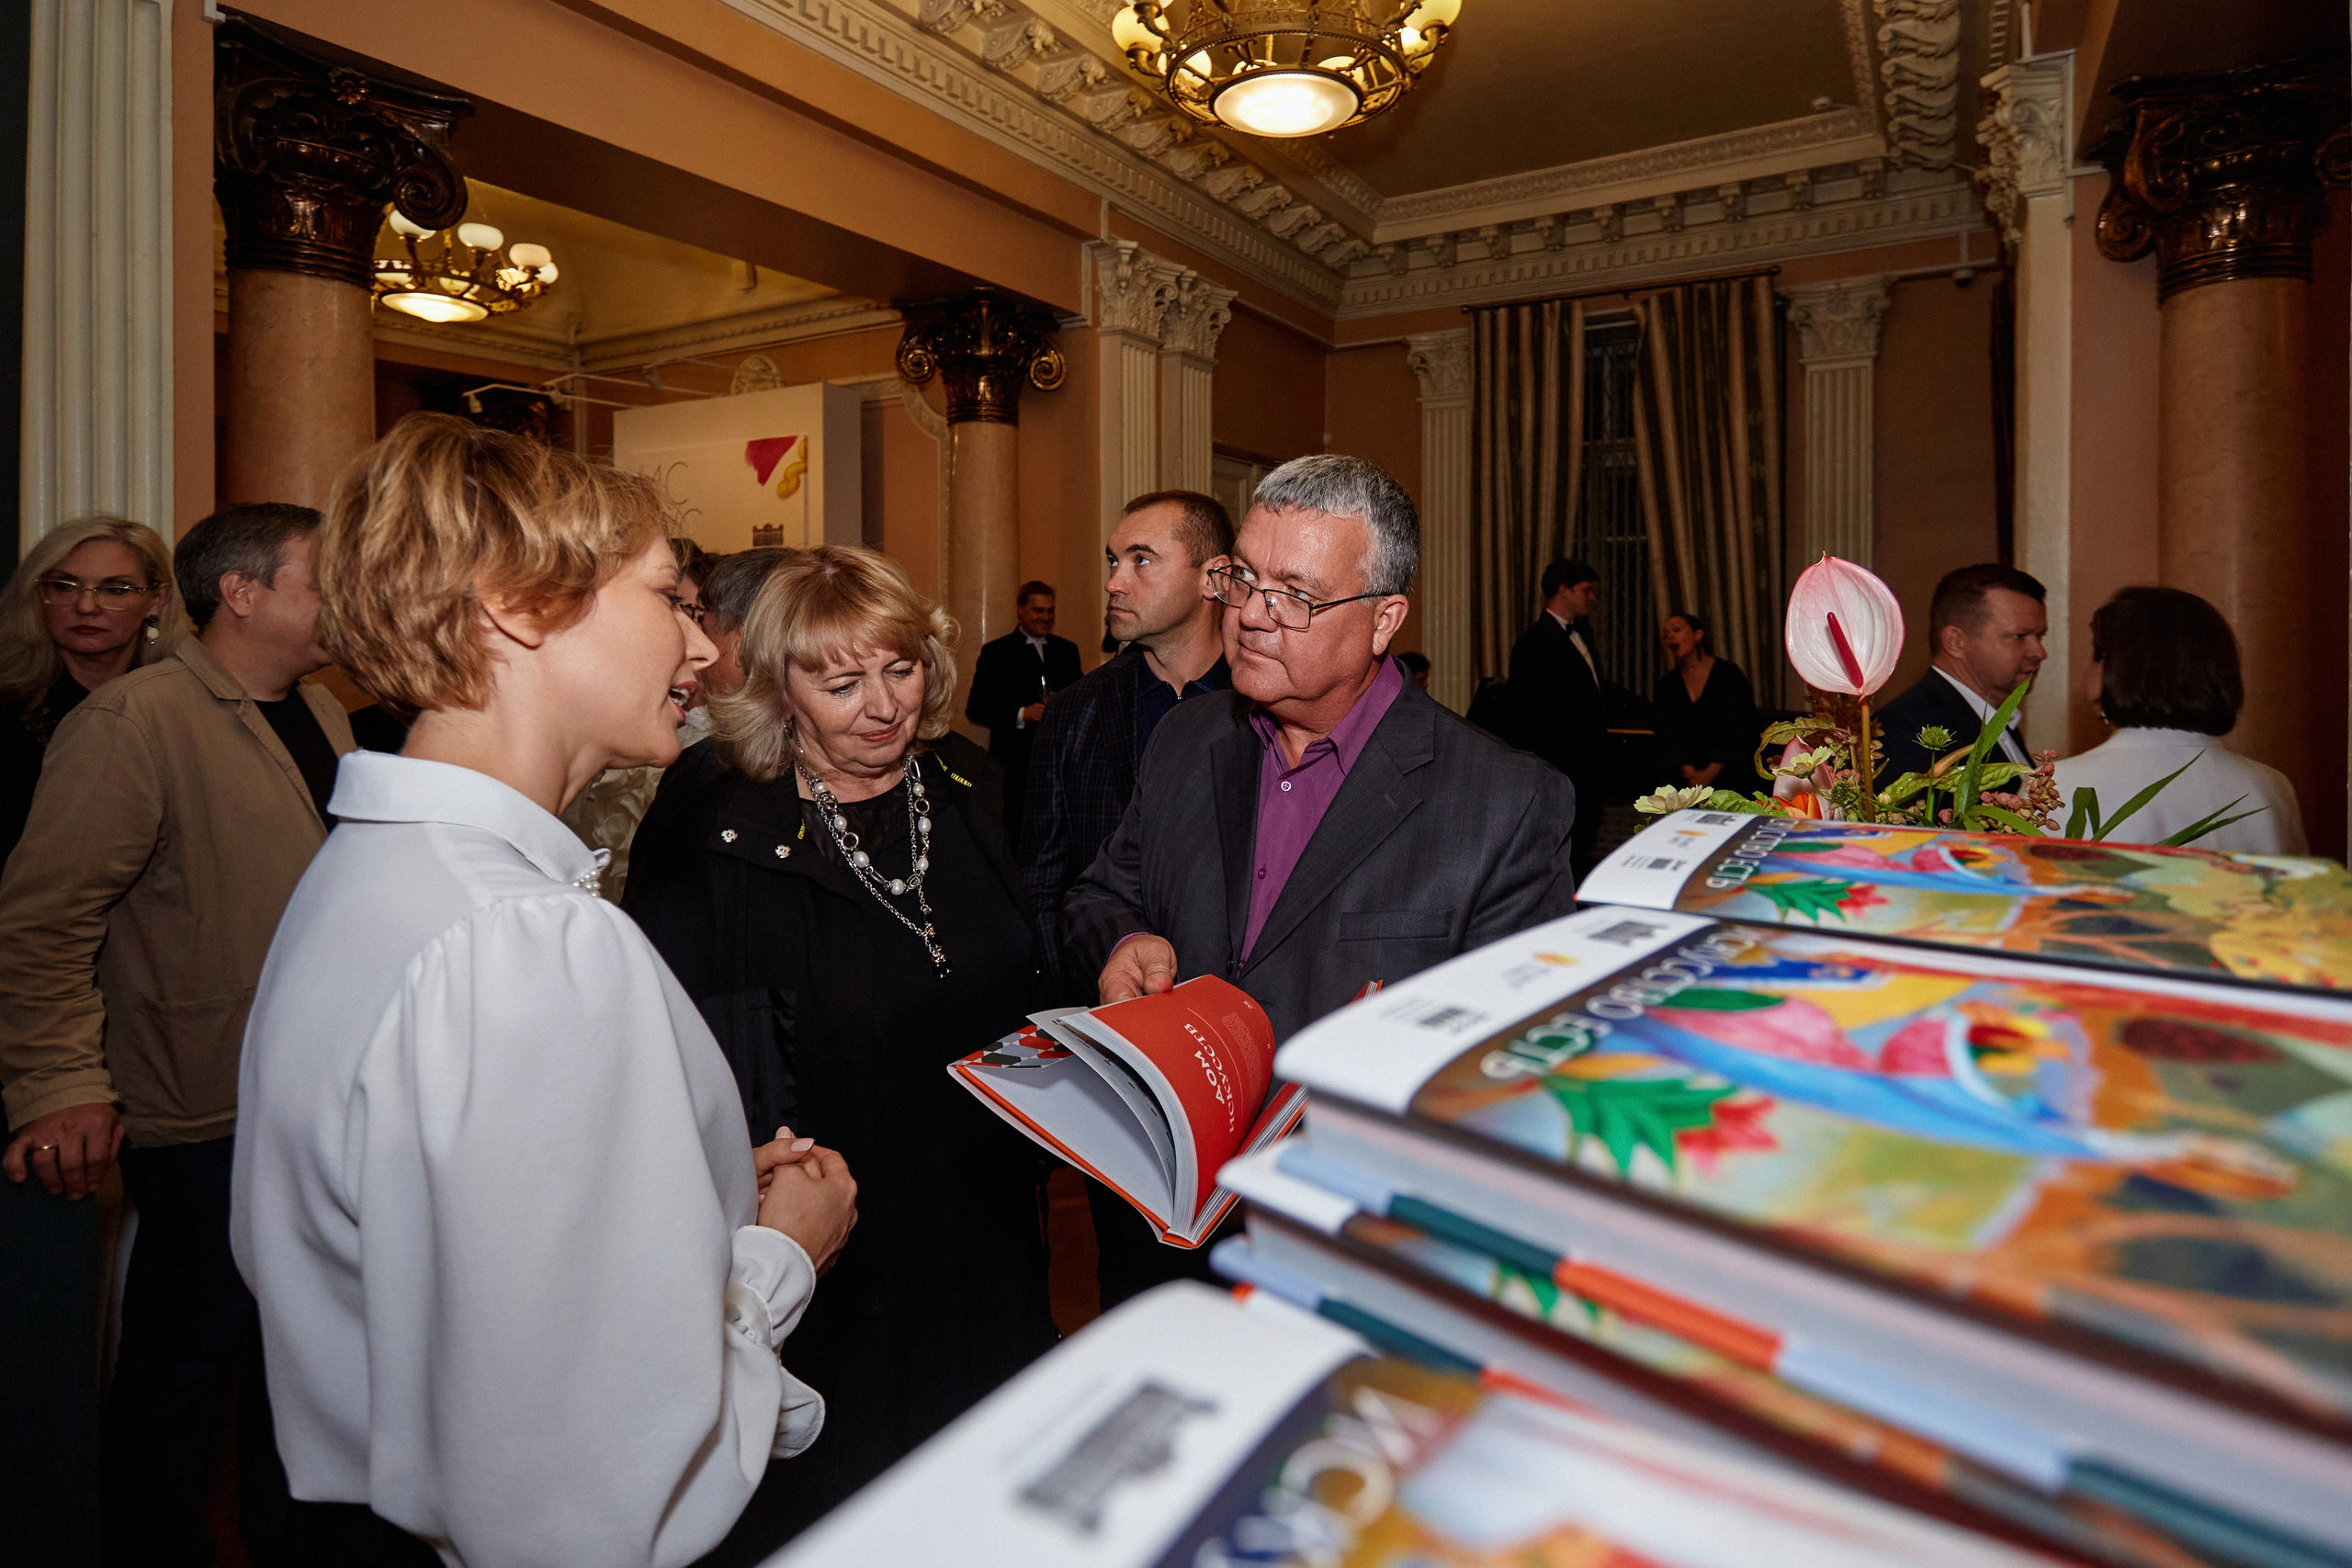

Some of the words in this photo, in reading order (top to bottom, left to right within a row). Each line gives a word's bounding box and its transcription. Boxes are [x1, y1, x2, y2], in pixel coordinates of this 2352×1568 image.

[1706, 857, 1759, 888] ЕСТЬ
[1480, 1011, 1612, 1080] ЕСТЬ
[1184, 1023, 1235, 1133] ИСКУССТВ
[1194, 1050, 1225, 1104] ДОМ
